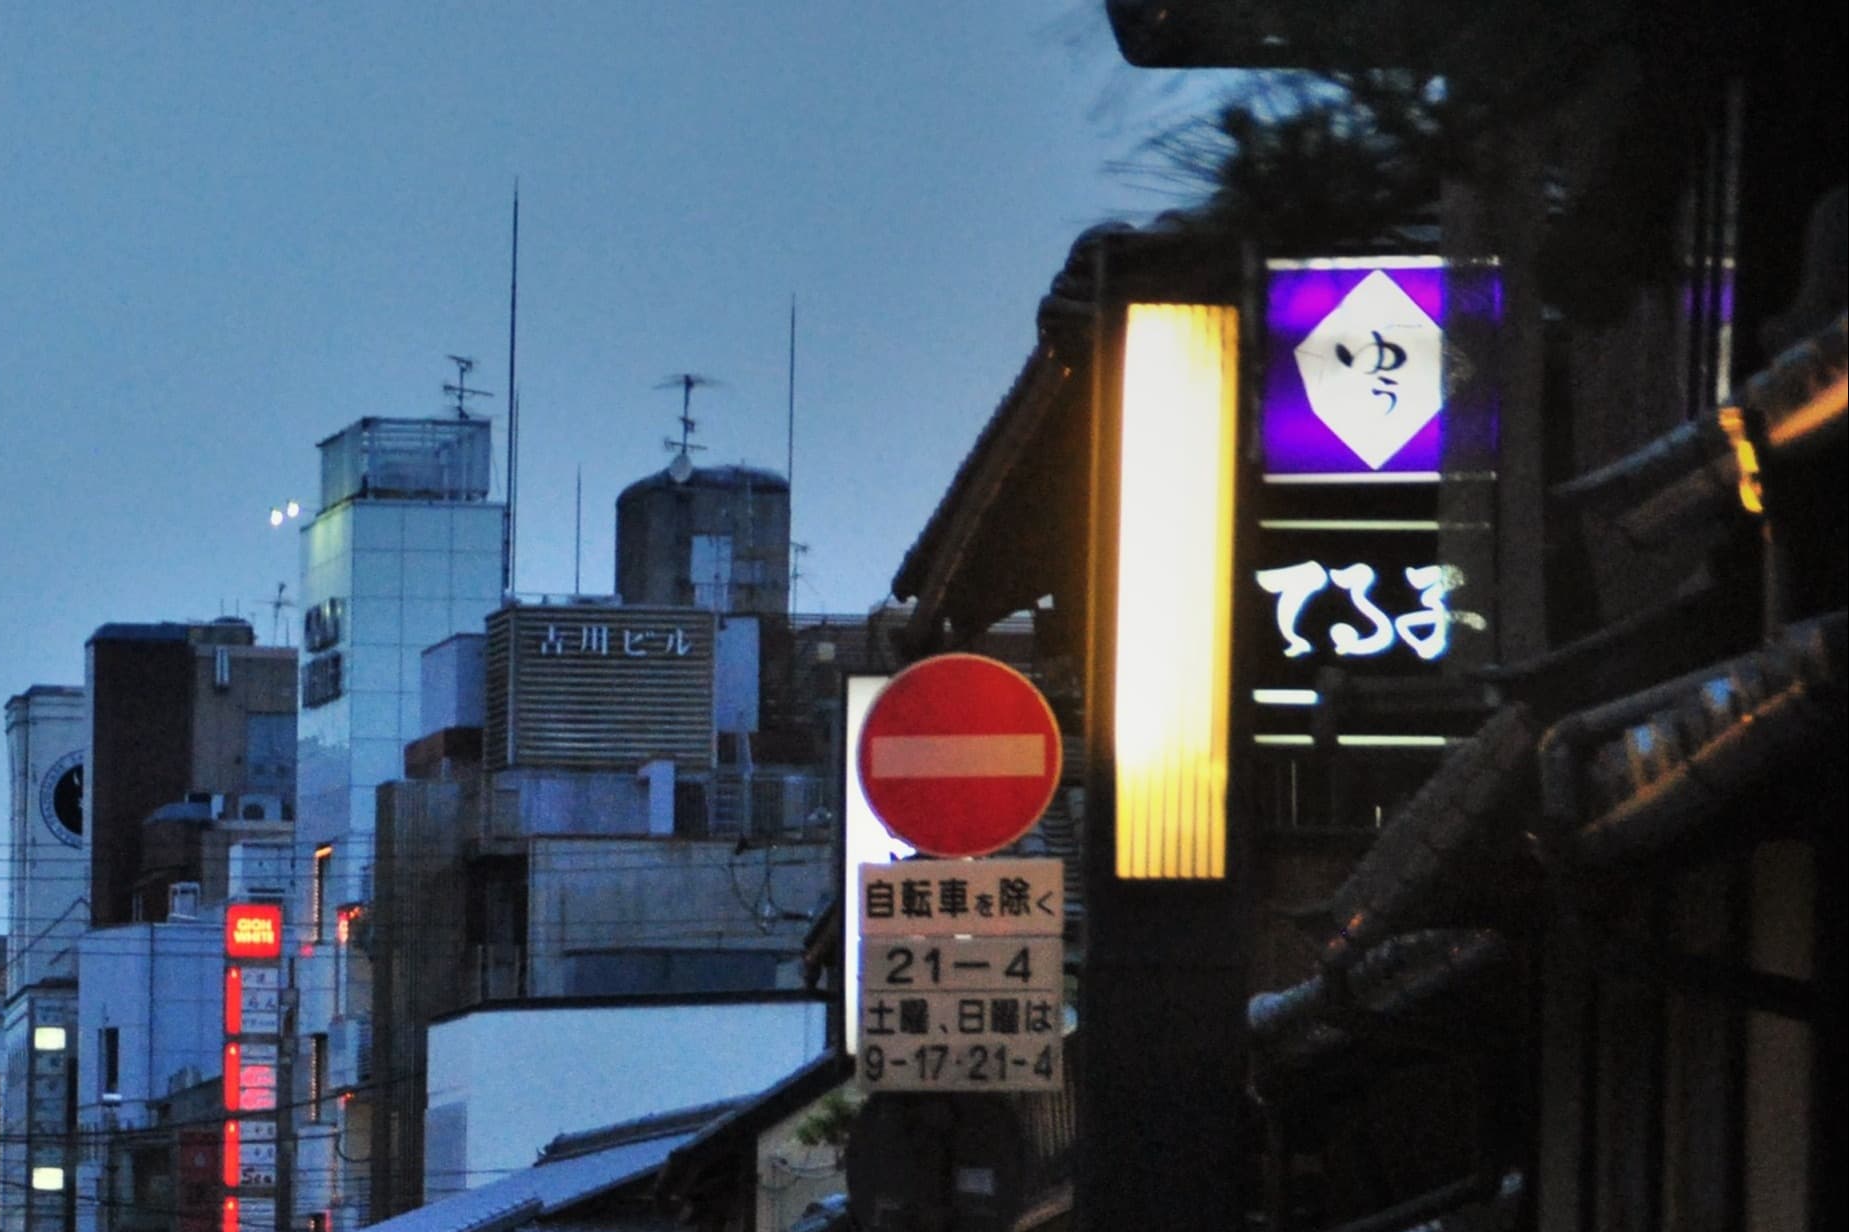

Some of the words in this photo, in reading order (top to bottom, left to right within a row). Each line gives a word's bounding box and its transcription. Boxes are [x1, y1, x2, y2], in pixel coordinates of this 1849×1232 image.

[864, 877, 1055, 919] 自転車を除く
